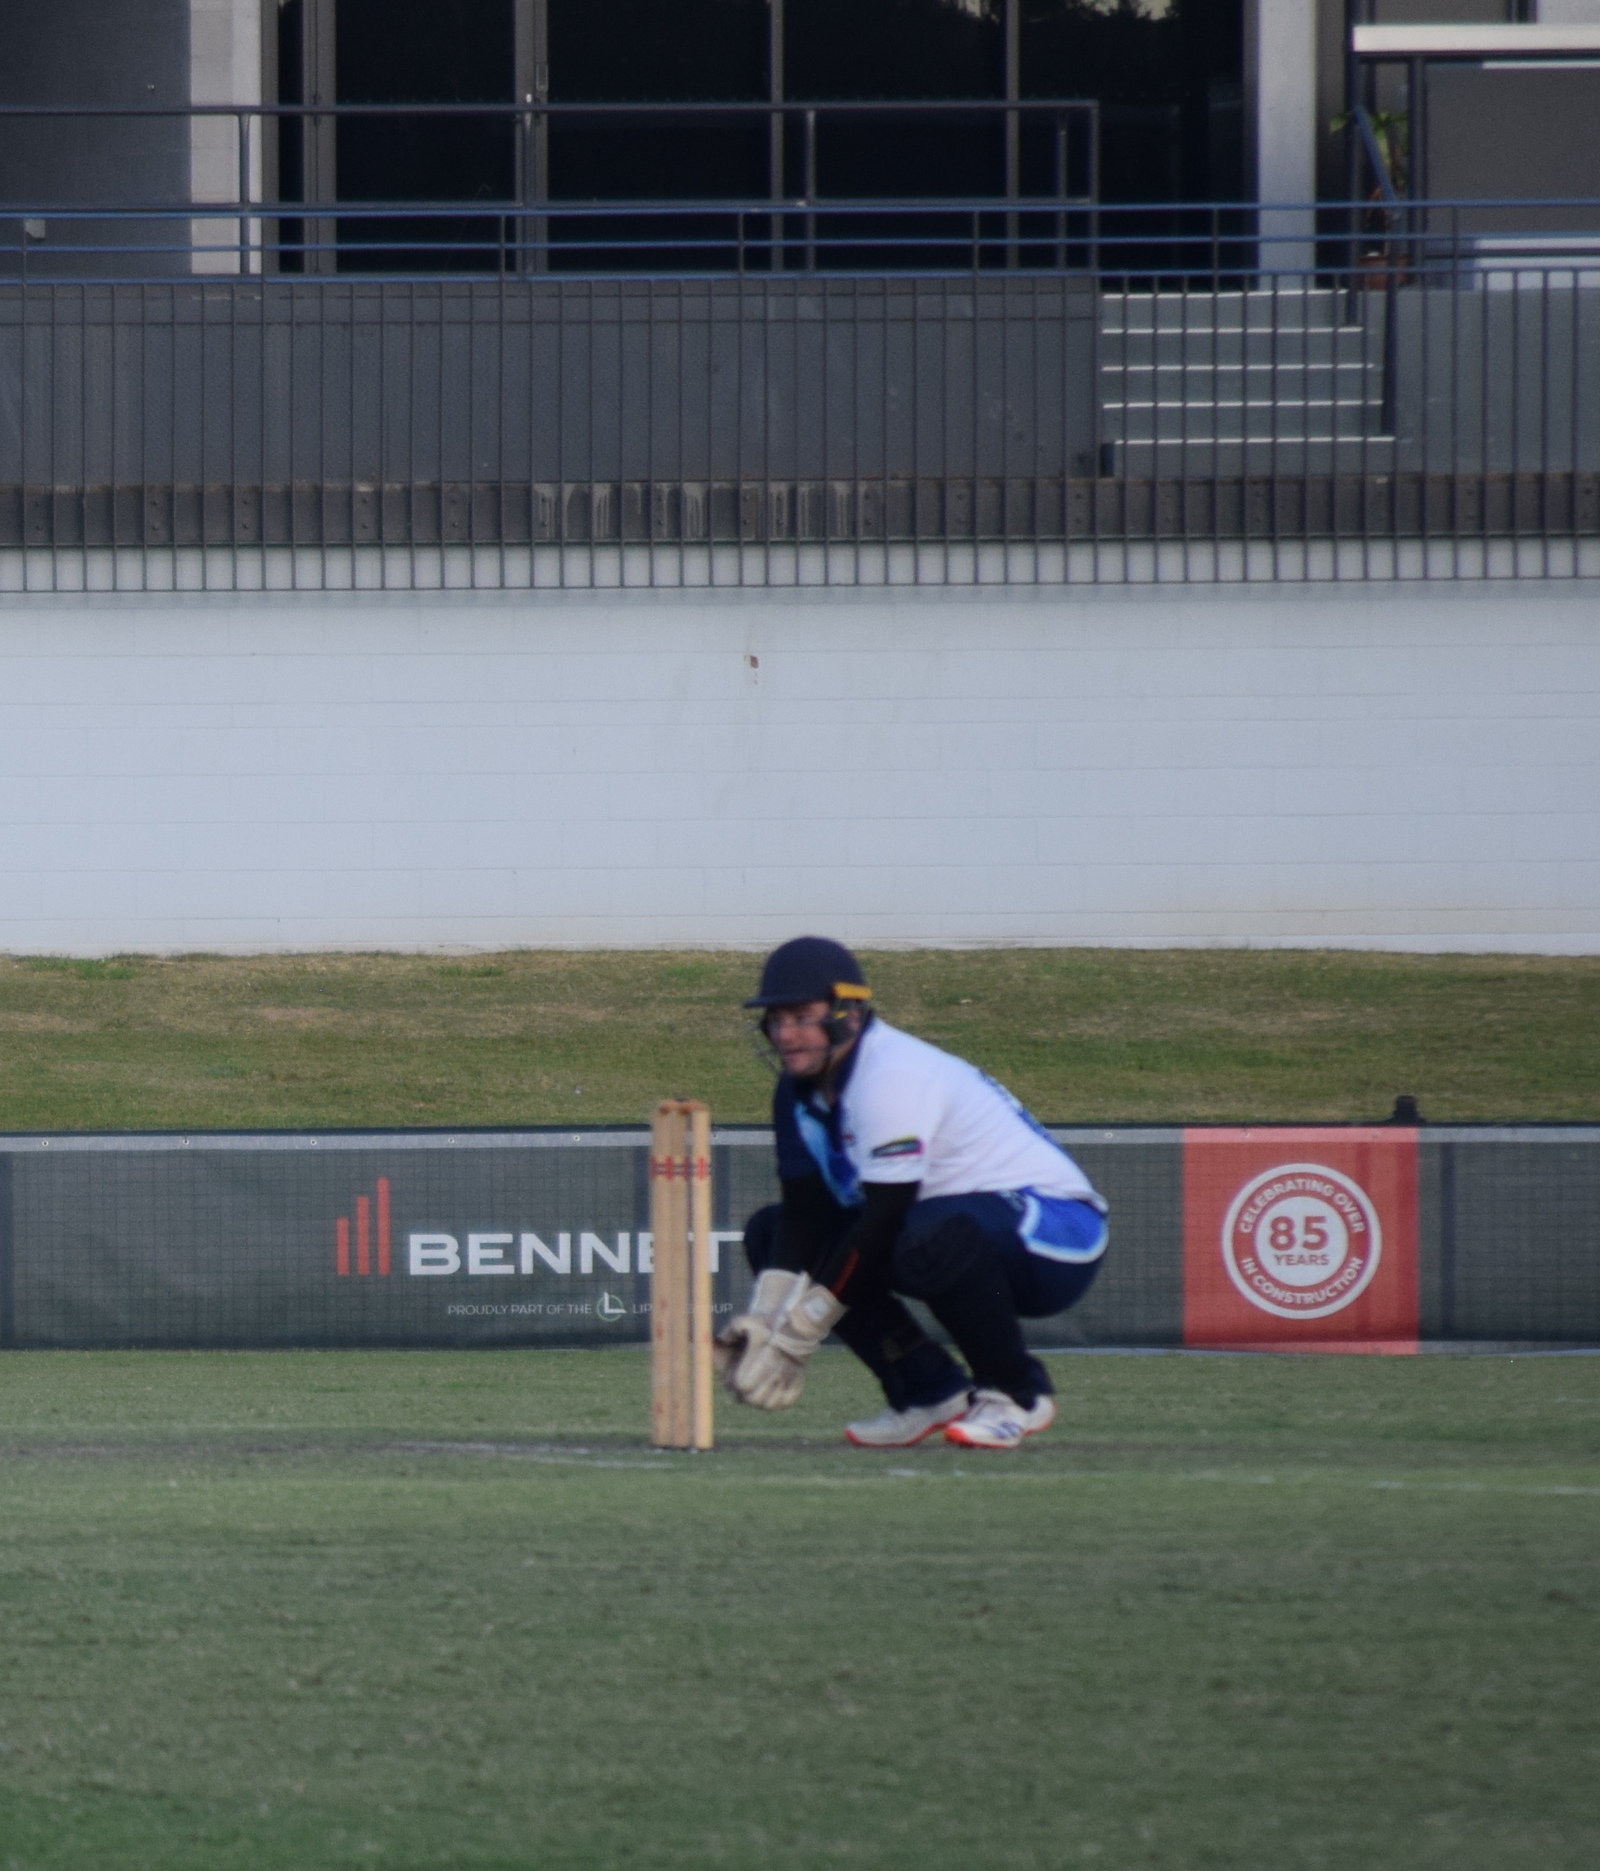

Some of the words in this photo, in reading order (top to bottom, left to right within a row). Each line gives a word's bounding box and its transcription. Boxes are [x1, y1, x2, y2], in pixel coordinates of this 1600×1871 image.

[1239, 1178, 1335, 1234] CELEBRATING
[1333, 1193, 1366, 1234] OVER
[1269, 1215, 1330, 1251] 85
[1273, 1254, 1330, 1266] YEARS
[1241, 1257, 1258, 1275] IN
[1253, 1257, 1364, 1305] CONSTRUCTION
[448, 1304, 508, 1316] PROUDLY
[510, 1304, 543, 1315] PART
[546, 1304, 565, 1315] OF
[568, 1303, 592, 1315] THE
